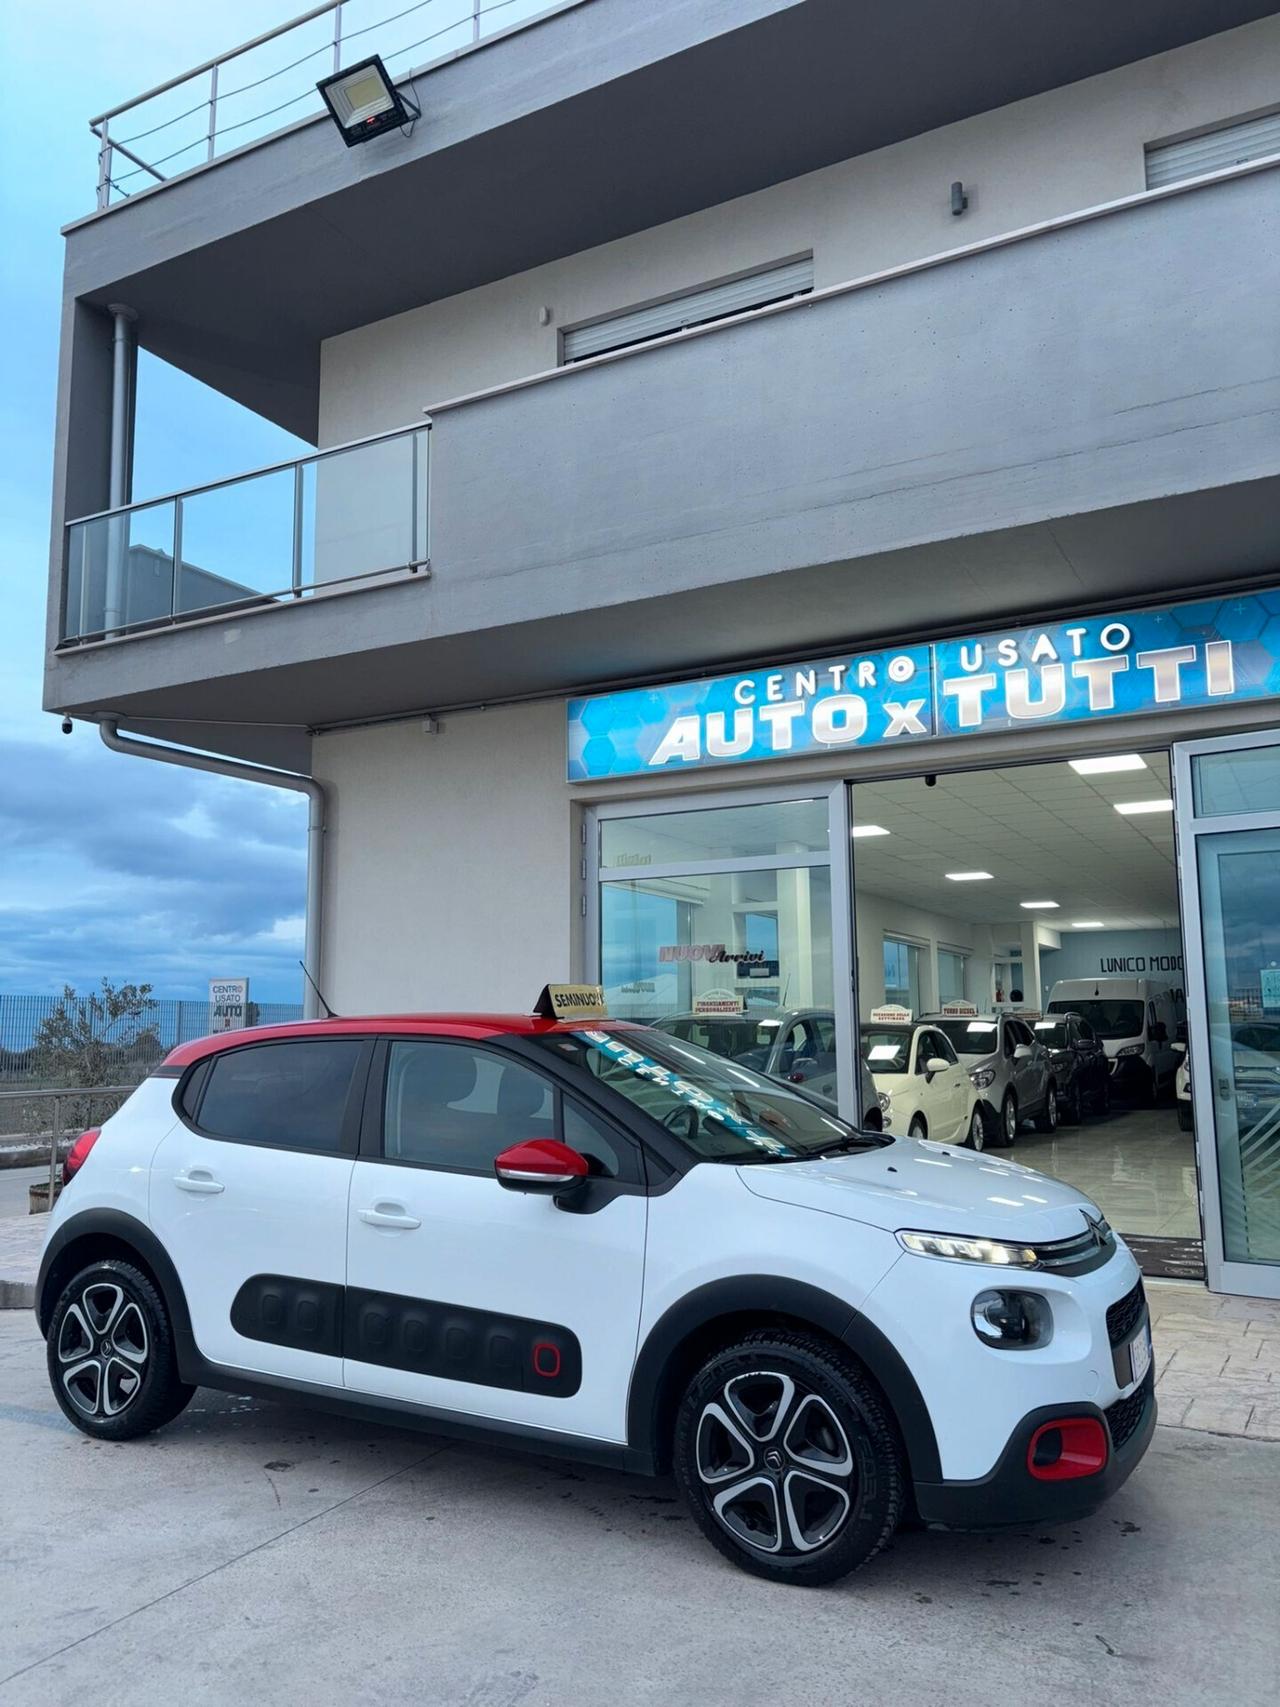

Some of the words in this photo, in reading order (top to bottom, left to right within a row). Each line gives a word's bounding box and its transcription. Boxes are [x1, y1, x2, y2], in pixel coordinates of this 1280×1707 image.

[735, 655, 915, 705] CENTRO
[960, 622, 1130, 672] USATO
[648, 694, 868, 765] AUTO
[943, 640, 1235, 727] TUTTI
[709, 950, 765, 963] Arrivi
[1100, 957, 1146, 973] LUNICO
[212, 985, 243, 993] CENTRO
[213, 1005, 242, 1017] AUTO
